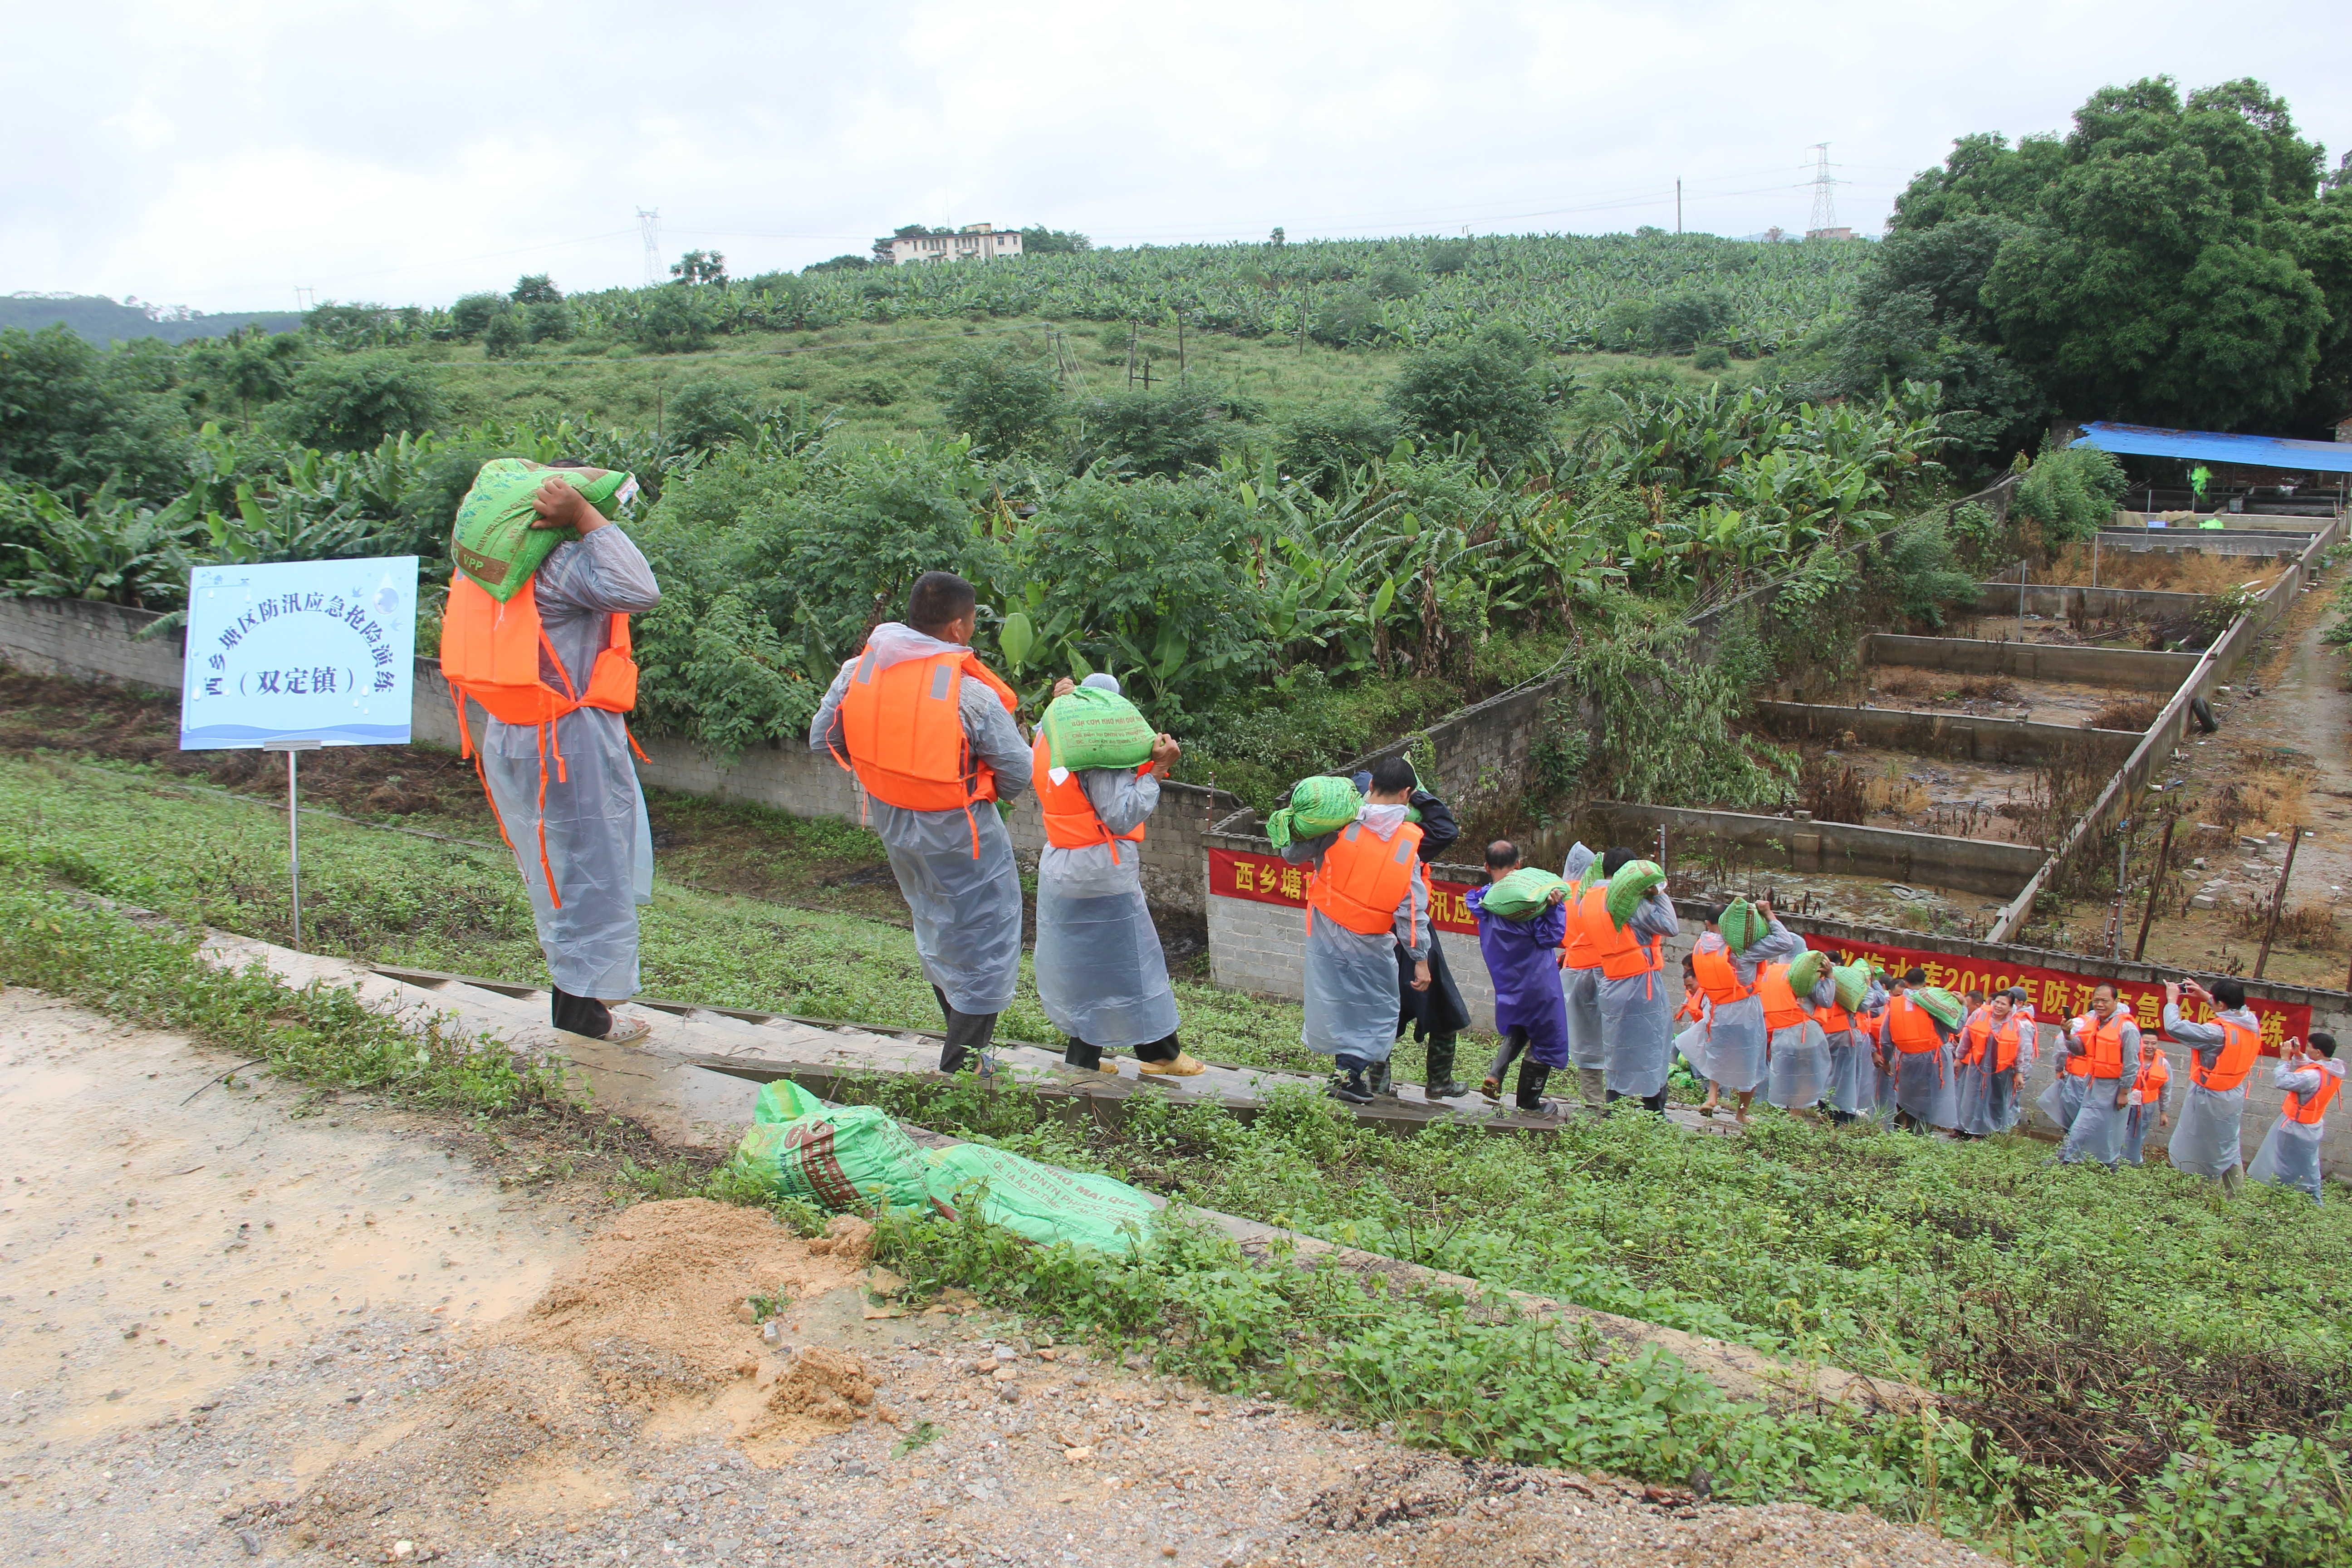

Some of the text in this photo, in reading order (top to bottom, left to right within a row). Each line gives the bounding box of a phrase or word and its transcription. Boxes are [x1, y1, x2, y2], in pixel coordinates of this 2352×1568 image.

[463, 554, 485, 571] VPP
[205, 592, 396, 697] 西乡塘区防汛应急抢险演练
[1234, 861, 1312, 900] 西乡塘
[993, 1161, 1004, 1173] QL
[1005, 1171, 1016, 1181] 1A
[1029, 1172, 1062, 1196] DNTN
